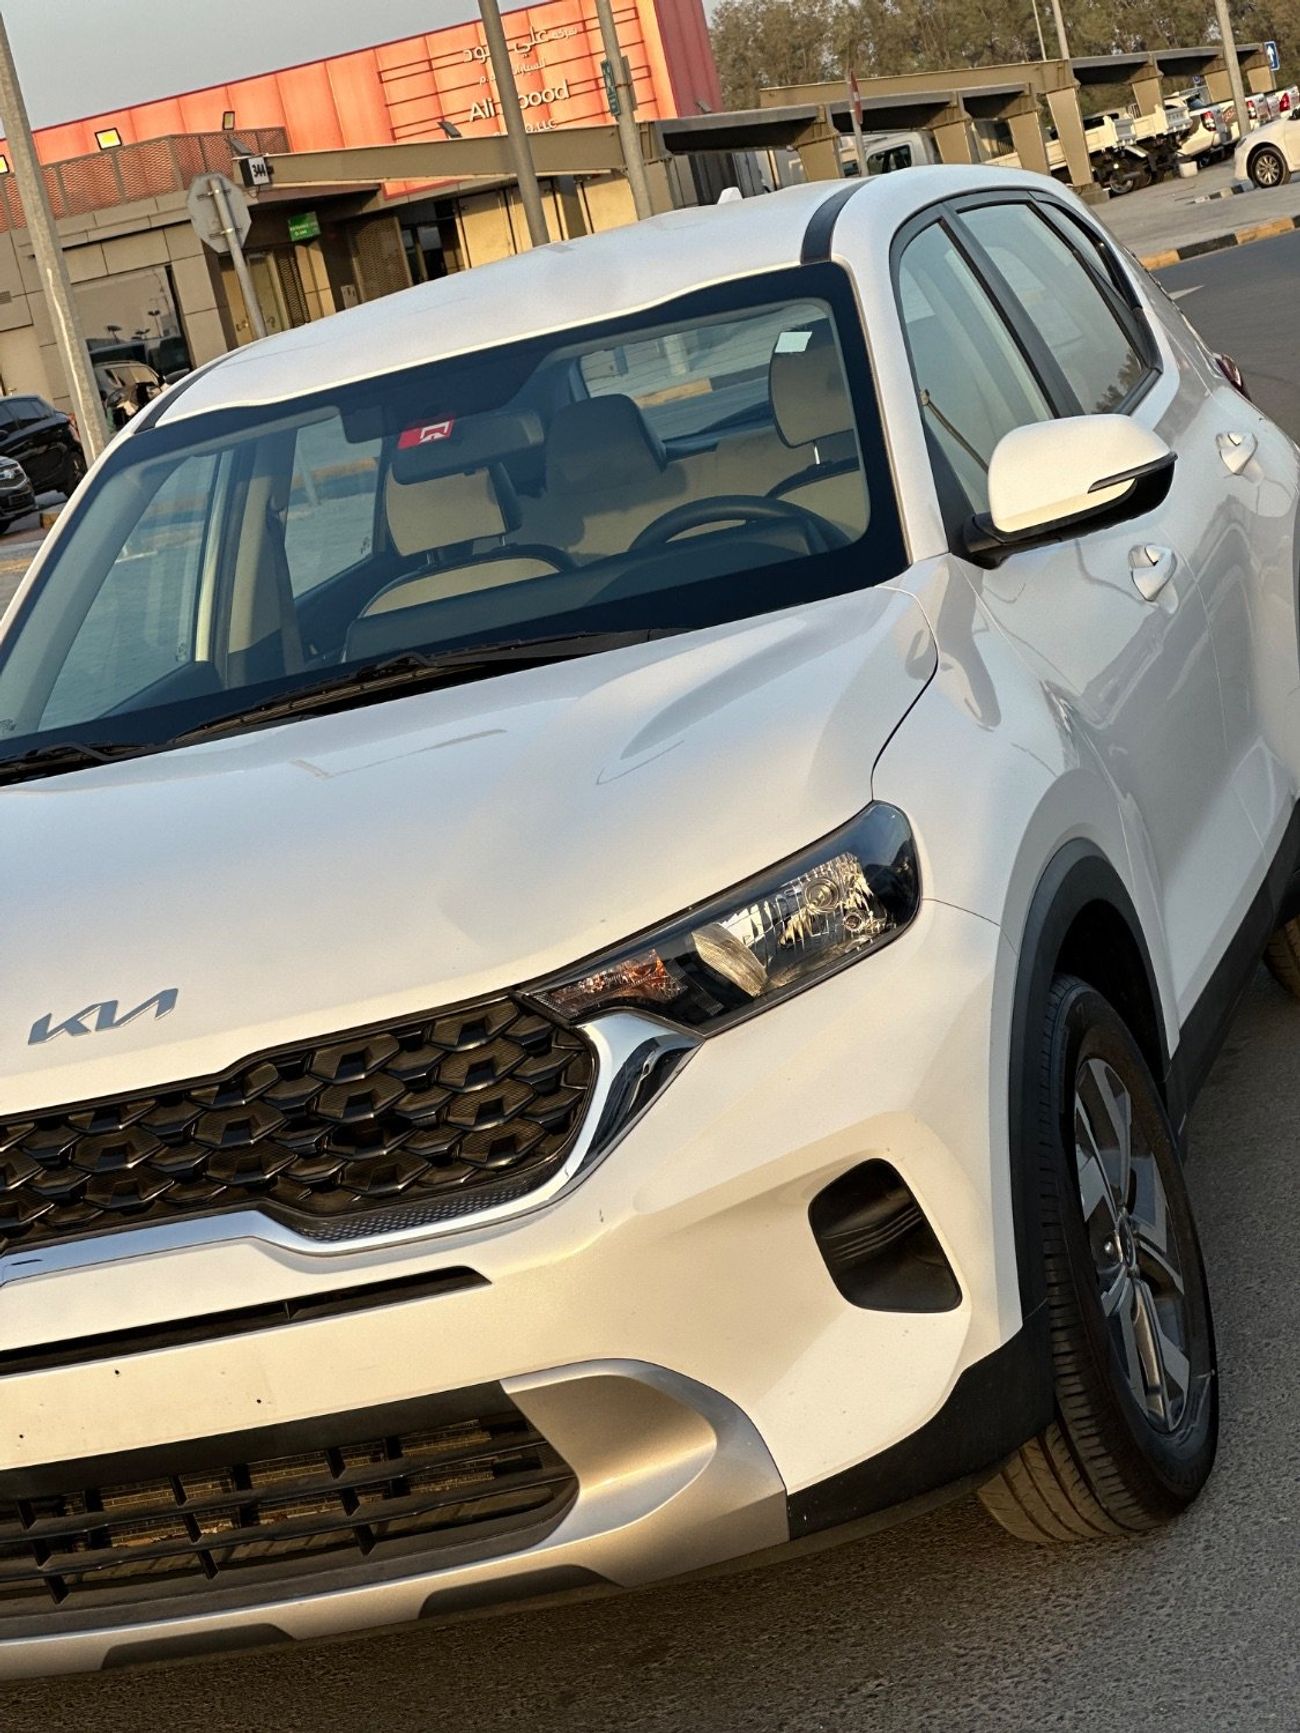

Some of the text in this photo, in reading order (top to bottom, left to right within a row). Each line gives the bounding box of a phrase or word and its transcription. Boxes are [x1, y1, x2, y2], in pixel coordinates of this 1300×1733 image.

[514, 25, 547, 59] علي
[469, 97, 496, 122] Ali
[28, 988, 178, 1045] KIA
